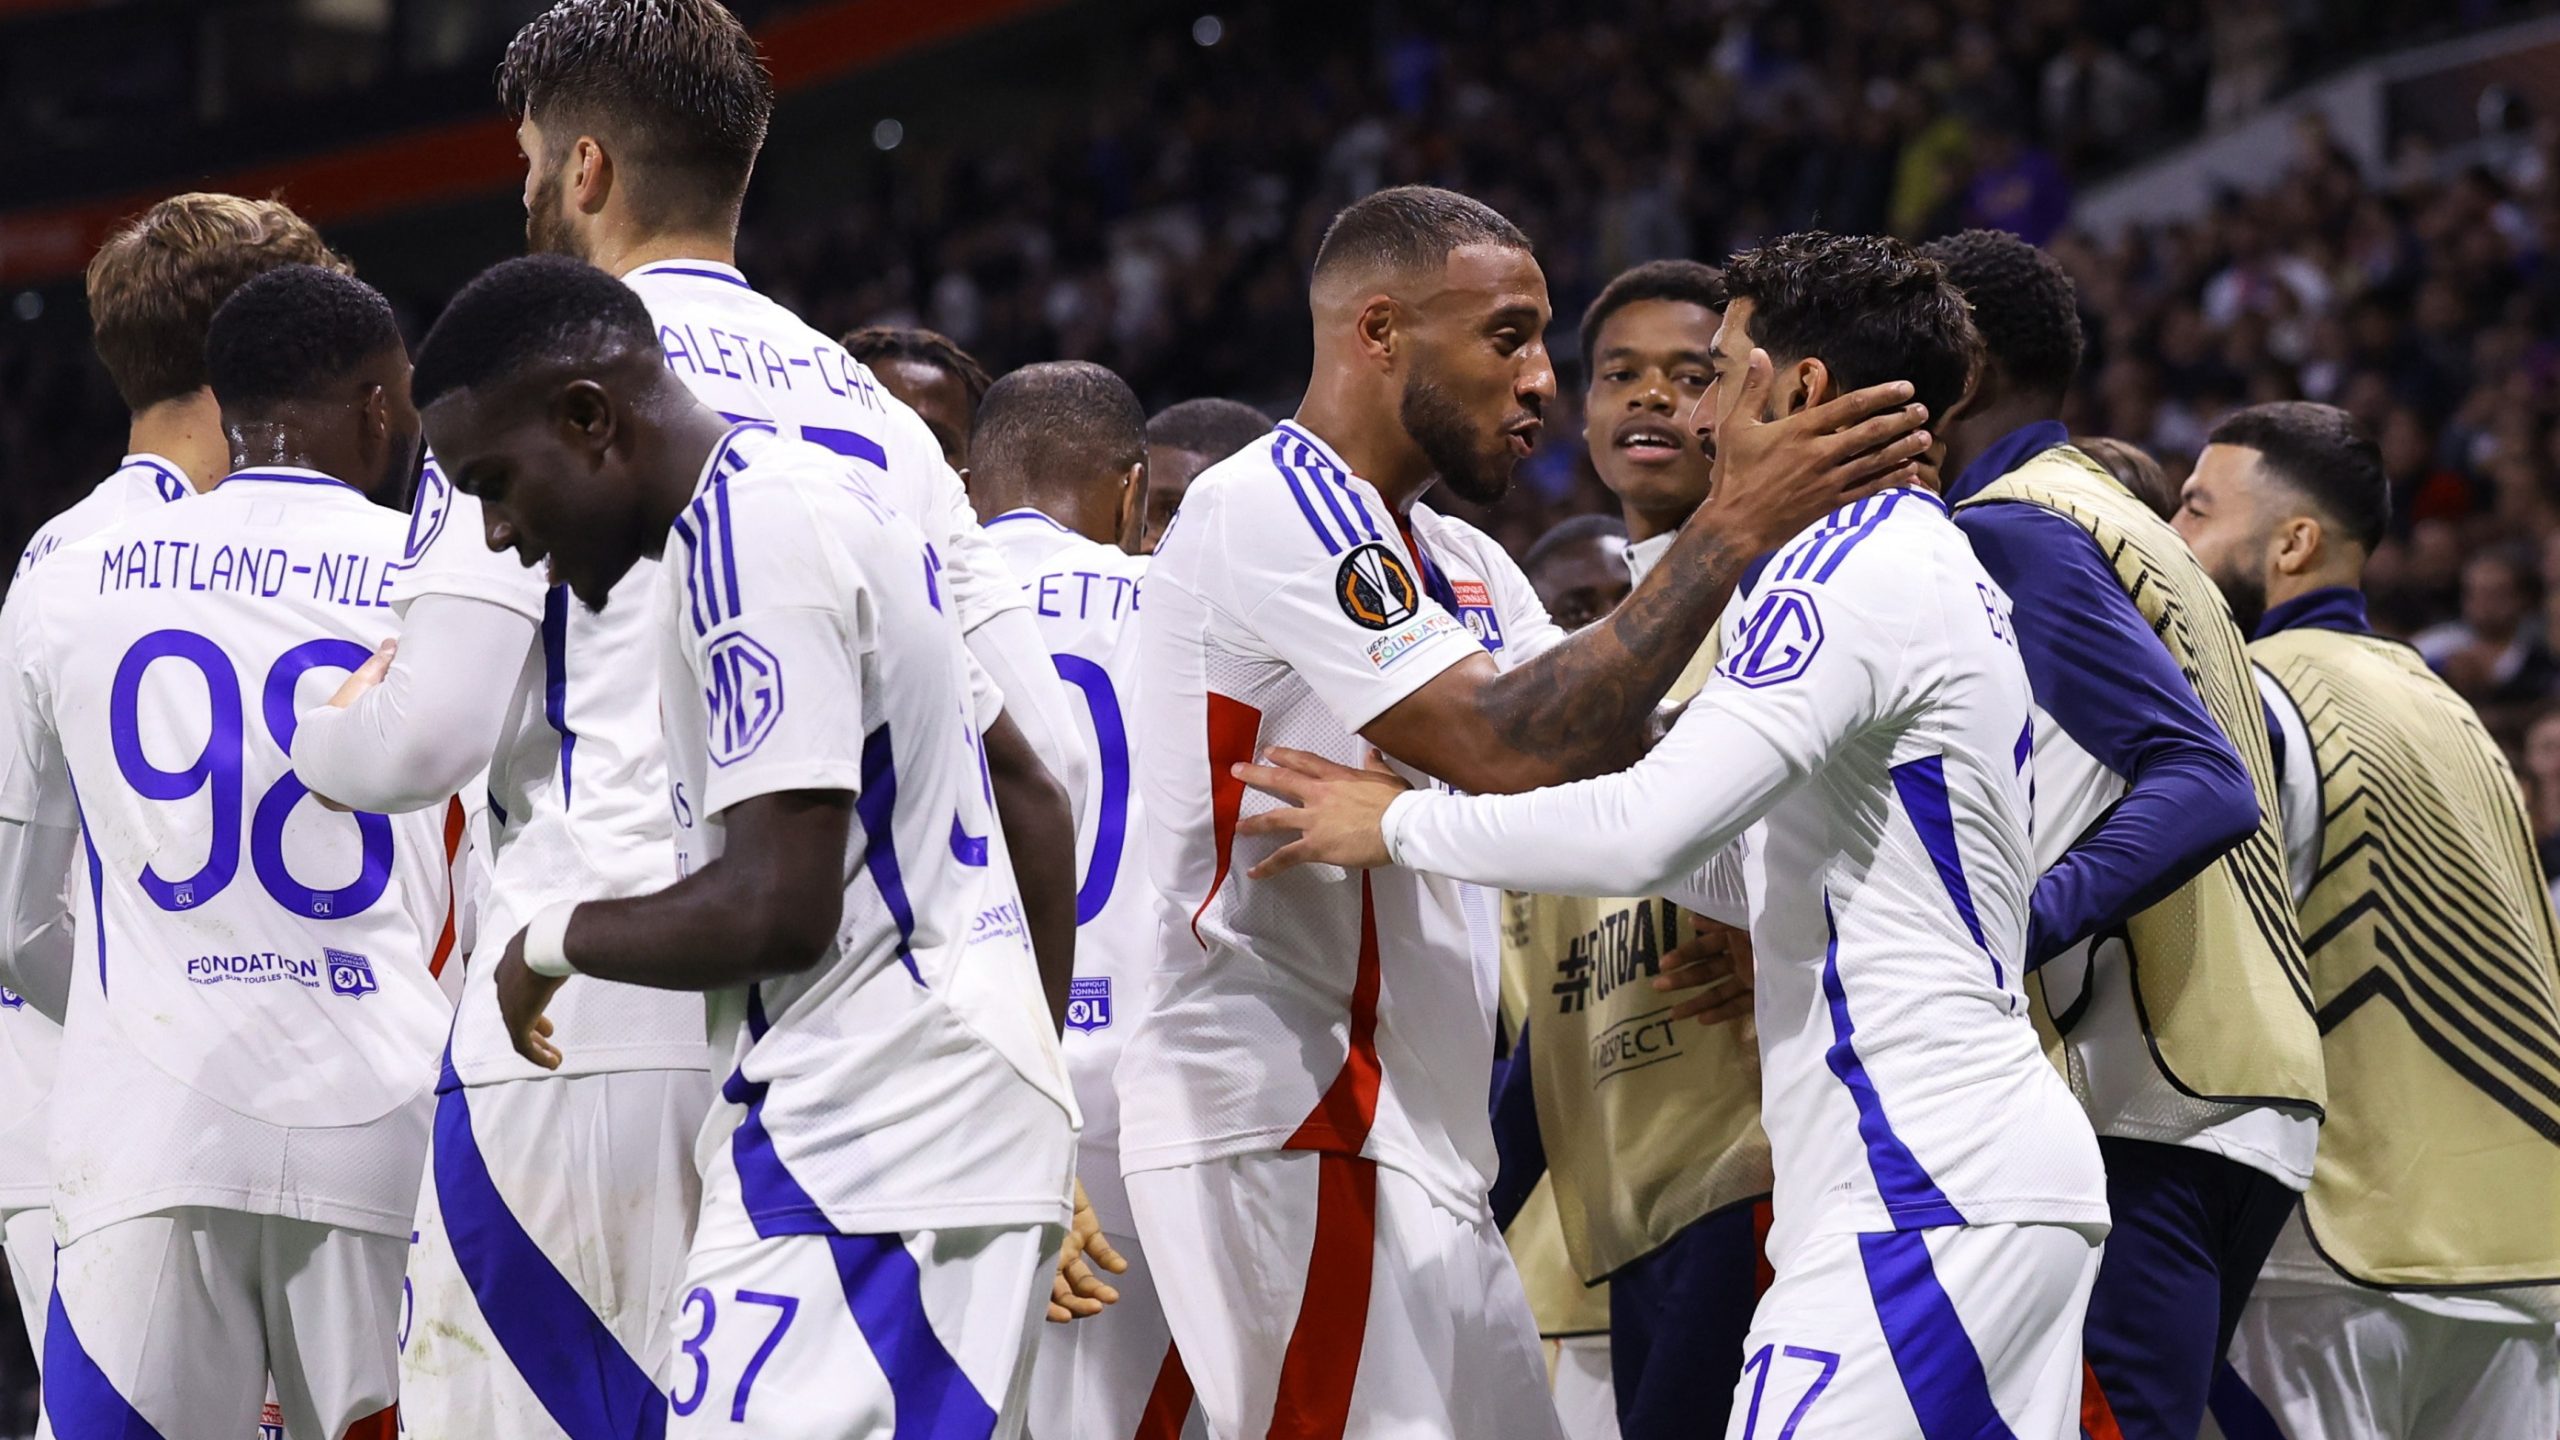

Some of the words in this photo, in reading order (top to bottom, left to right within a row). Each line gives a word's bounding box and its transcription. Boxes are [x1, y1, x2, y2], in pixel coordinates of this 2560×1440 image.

[1022, 572, 1144, 620] ETTE
[1366, 635, 1391, 655] UEFA
[706, 643, 769, 755] MG
[110, 628, 395, 920] 98
[187, 953, 317, 977] FONDATION
[225, 974, 242, 982] SUR
[244, 975, 267, 984] TOUS
[268, 973, 282, 982] LES
[334, 966, 374, 989] OL
[1070, 988, 1107, 996] YONNAIS
[1068, 1000, 1107, 1024] OL
[1592, 1018, 1674, 1069] ESPECT
[670, 1287, 799, 1424] 37
[1742, 1343, 1841, 1440] 17
